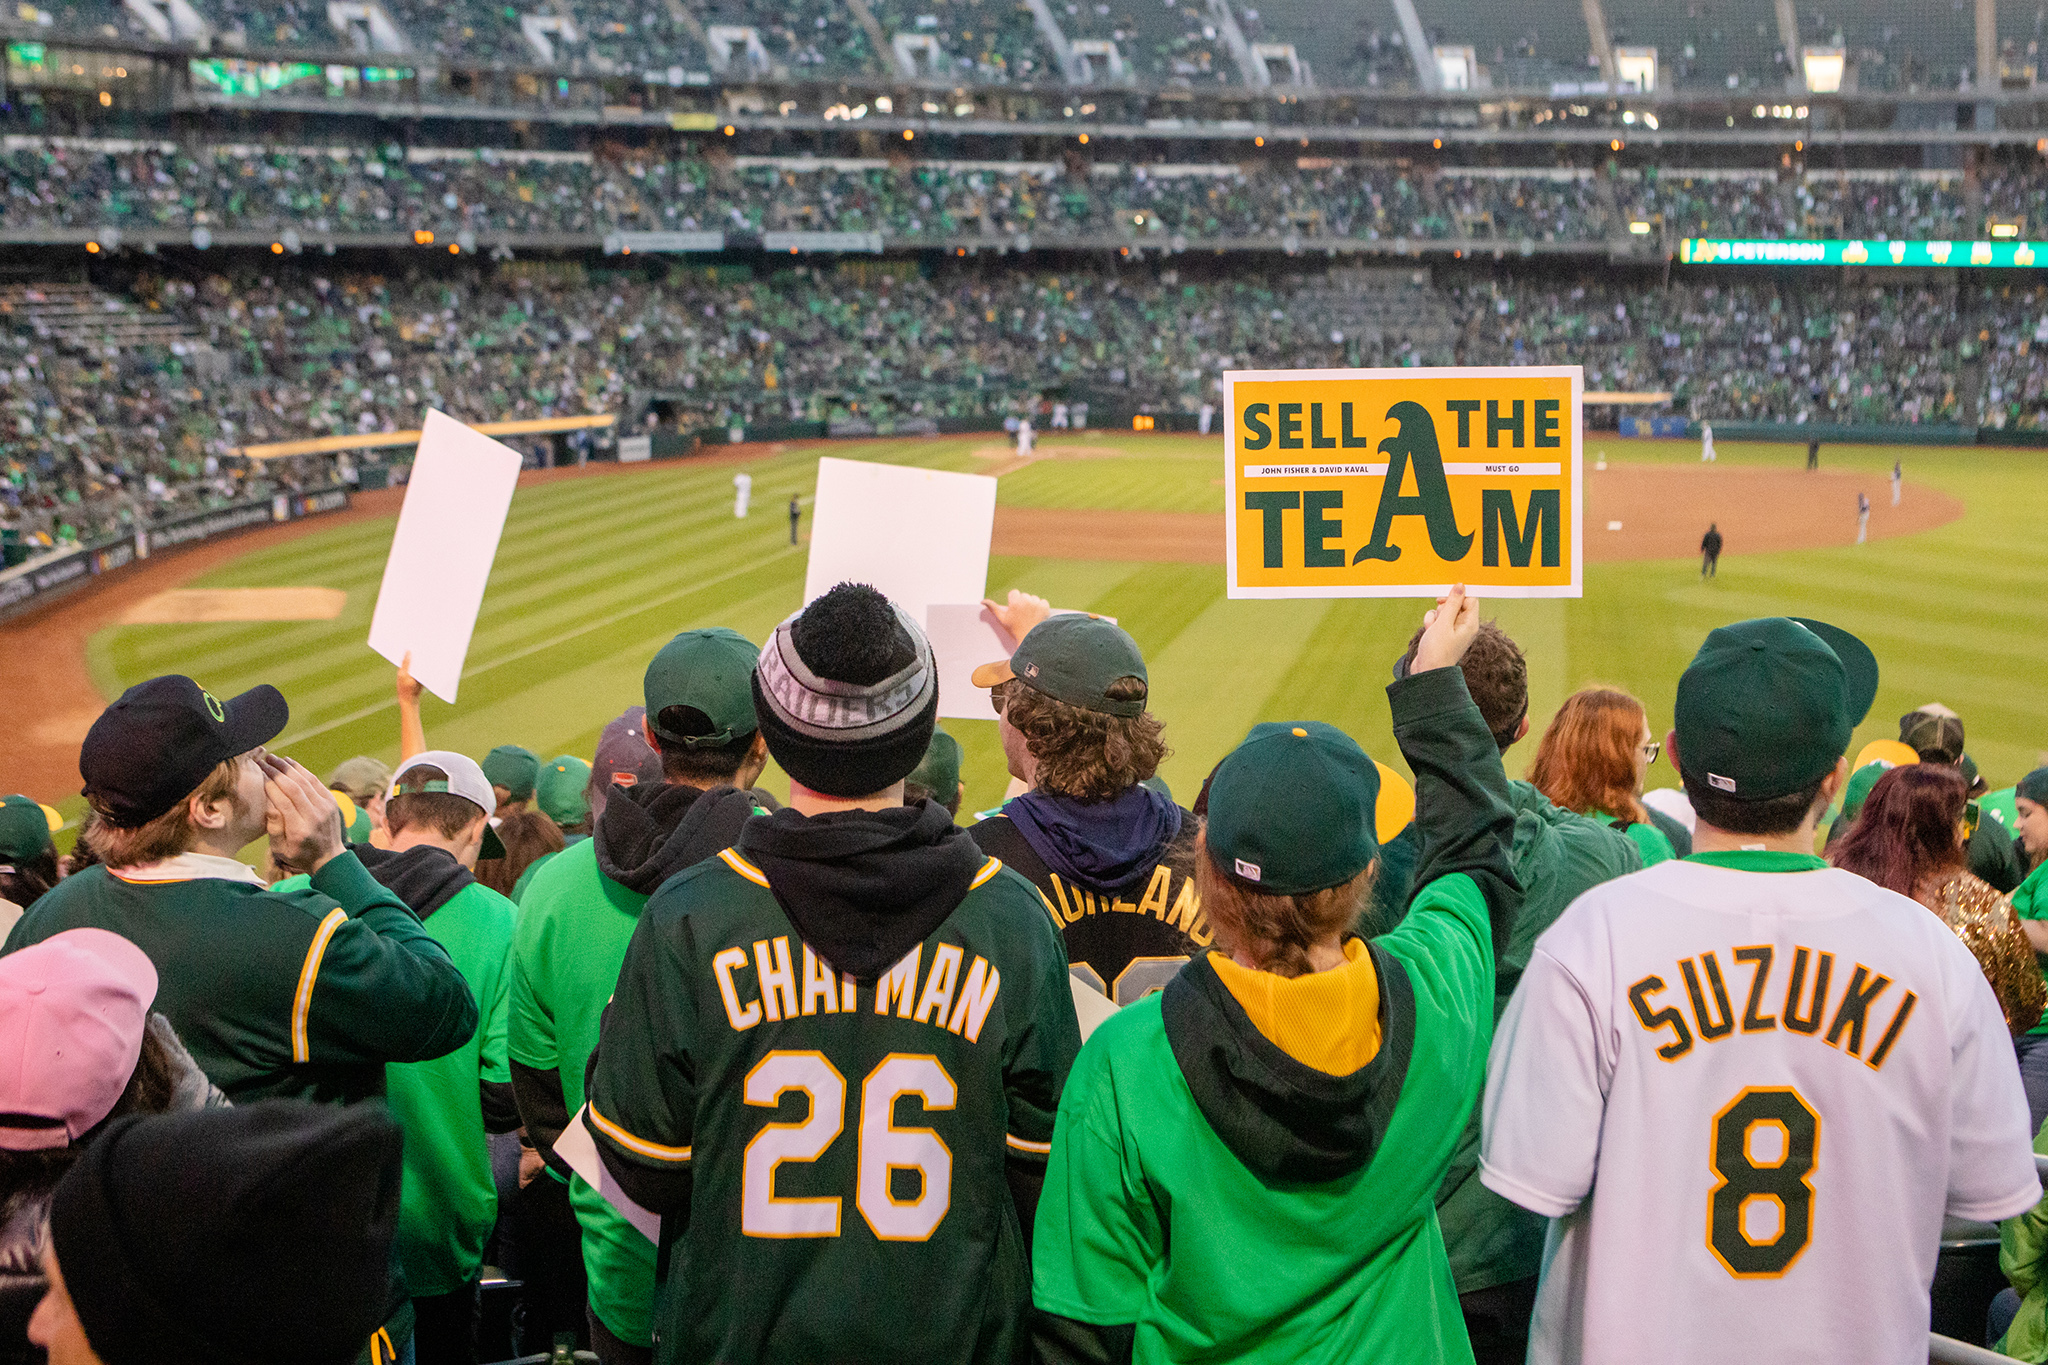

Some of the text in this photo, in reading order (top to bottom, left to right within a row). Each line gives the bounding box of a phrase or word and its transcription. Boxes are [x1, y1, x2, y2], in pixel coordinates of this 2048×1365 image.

[1243, 399, 1561, 451] SELL THE
[1284, 466, 1310, 474] FISHER
[1311, 466, 1317, 474] &
[1344, 465, 1369, 473] KAVAL
[1627, 943, 1919, 1071] SUZUKI
[741, 1049, 958, 1242] 26
[1705, 1085, 1822, 1280] 8
